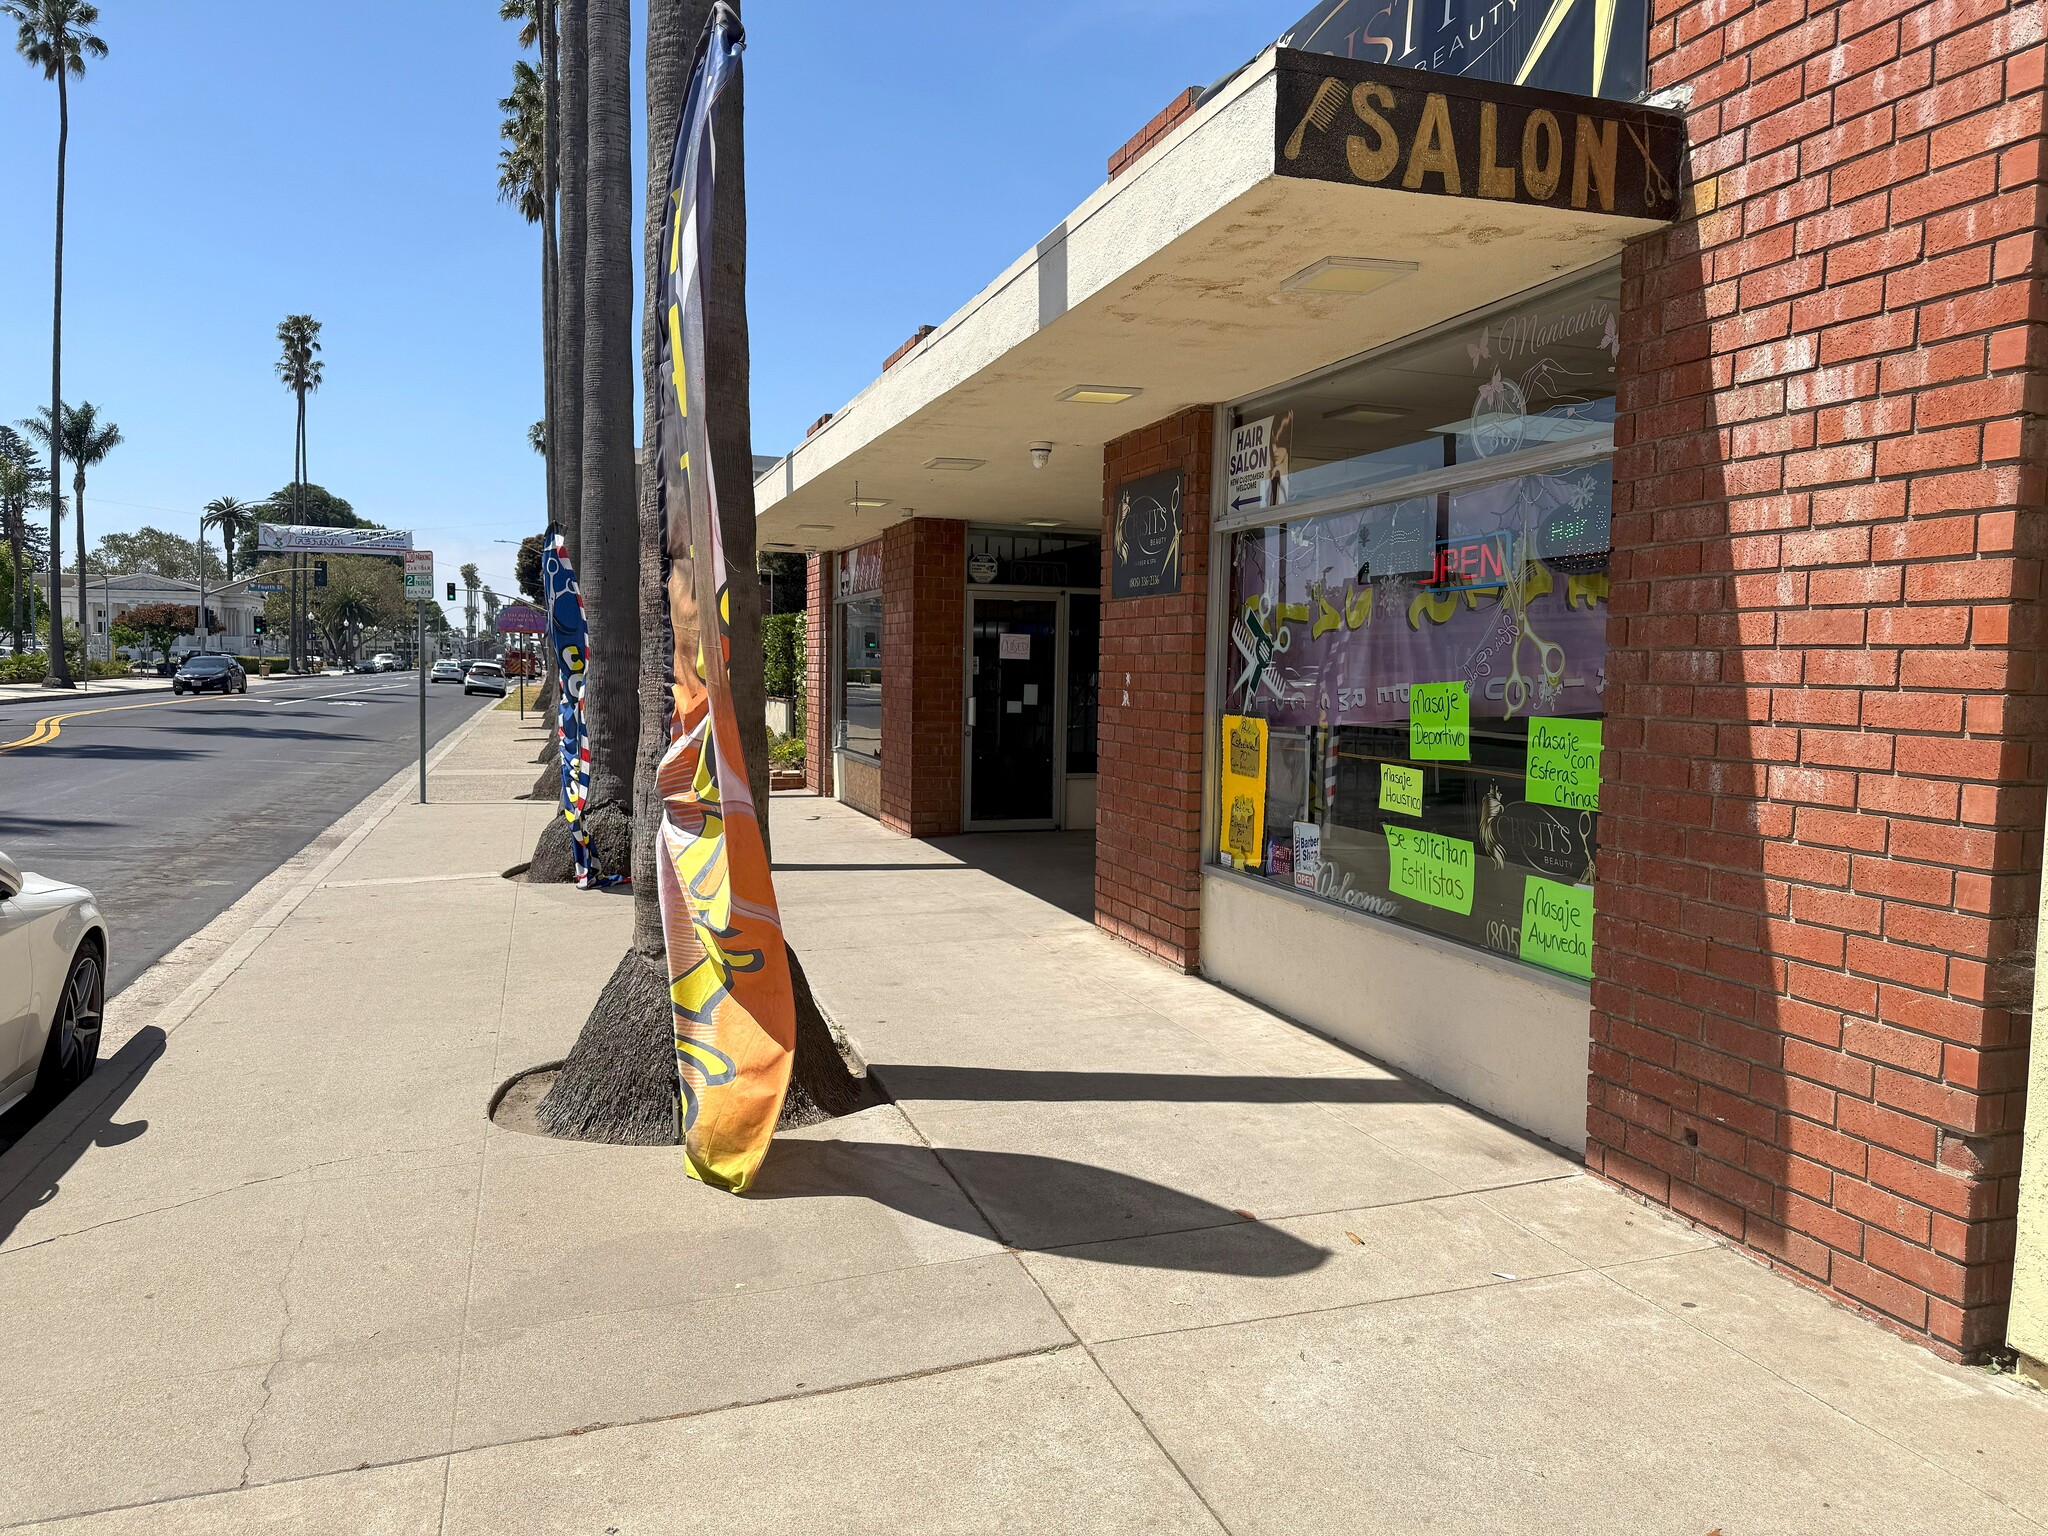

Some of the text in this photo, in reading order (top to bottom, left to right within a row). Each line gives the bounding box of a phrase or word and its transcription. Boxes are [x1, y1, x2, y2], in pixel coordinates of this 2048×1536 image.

[1346, 81, 1618, 211] SALON
[1499, 303, 1608, 360] Manicure
[1236, 425, 1263, 452] HAIR
[1230, 446, 1268, 476] SALON
[1236, 481, 1257, 493] WELCOME
[1239, 471, 1264, 484] CUSTOMERS
[295, 536, 345, 546] FESTIVAL
[1551, 516, 1588, 542] Hair
[407, 576, 413, 585] 2
[1001, 638, 1029, 654] CLOSED
[1412, 688, 1459, 721] Masaje
[1413, 722, 1465, 751] Deportivo
[1532, 725, 1595, 770] Masaje con
[1383, 767, 1413, 791] Masaje
[1529, 756, 1579, 785] Esferas
[1554, 784, 1600, 809] Chinas
[1301, 836, 1319, 849] Barber
[1388, 827, 1468, 868] Se solicitan
[1543, 855, 1574, 869] BEAUTY
[1297, 873, 1314, 886] OPEN
[1314, 859, 1397, 916] Welcome
[1401, 857, 1464, 901] Estilistas
[1526, 886, 1581, 932] Masaje
[1528, 921, 1587, 958] Ayurveda
